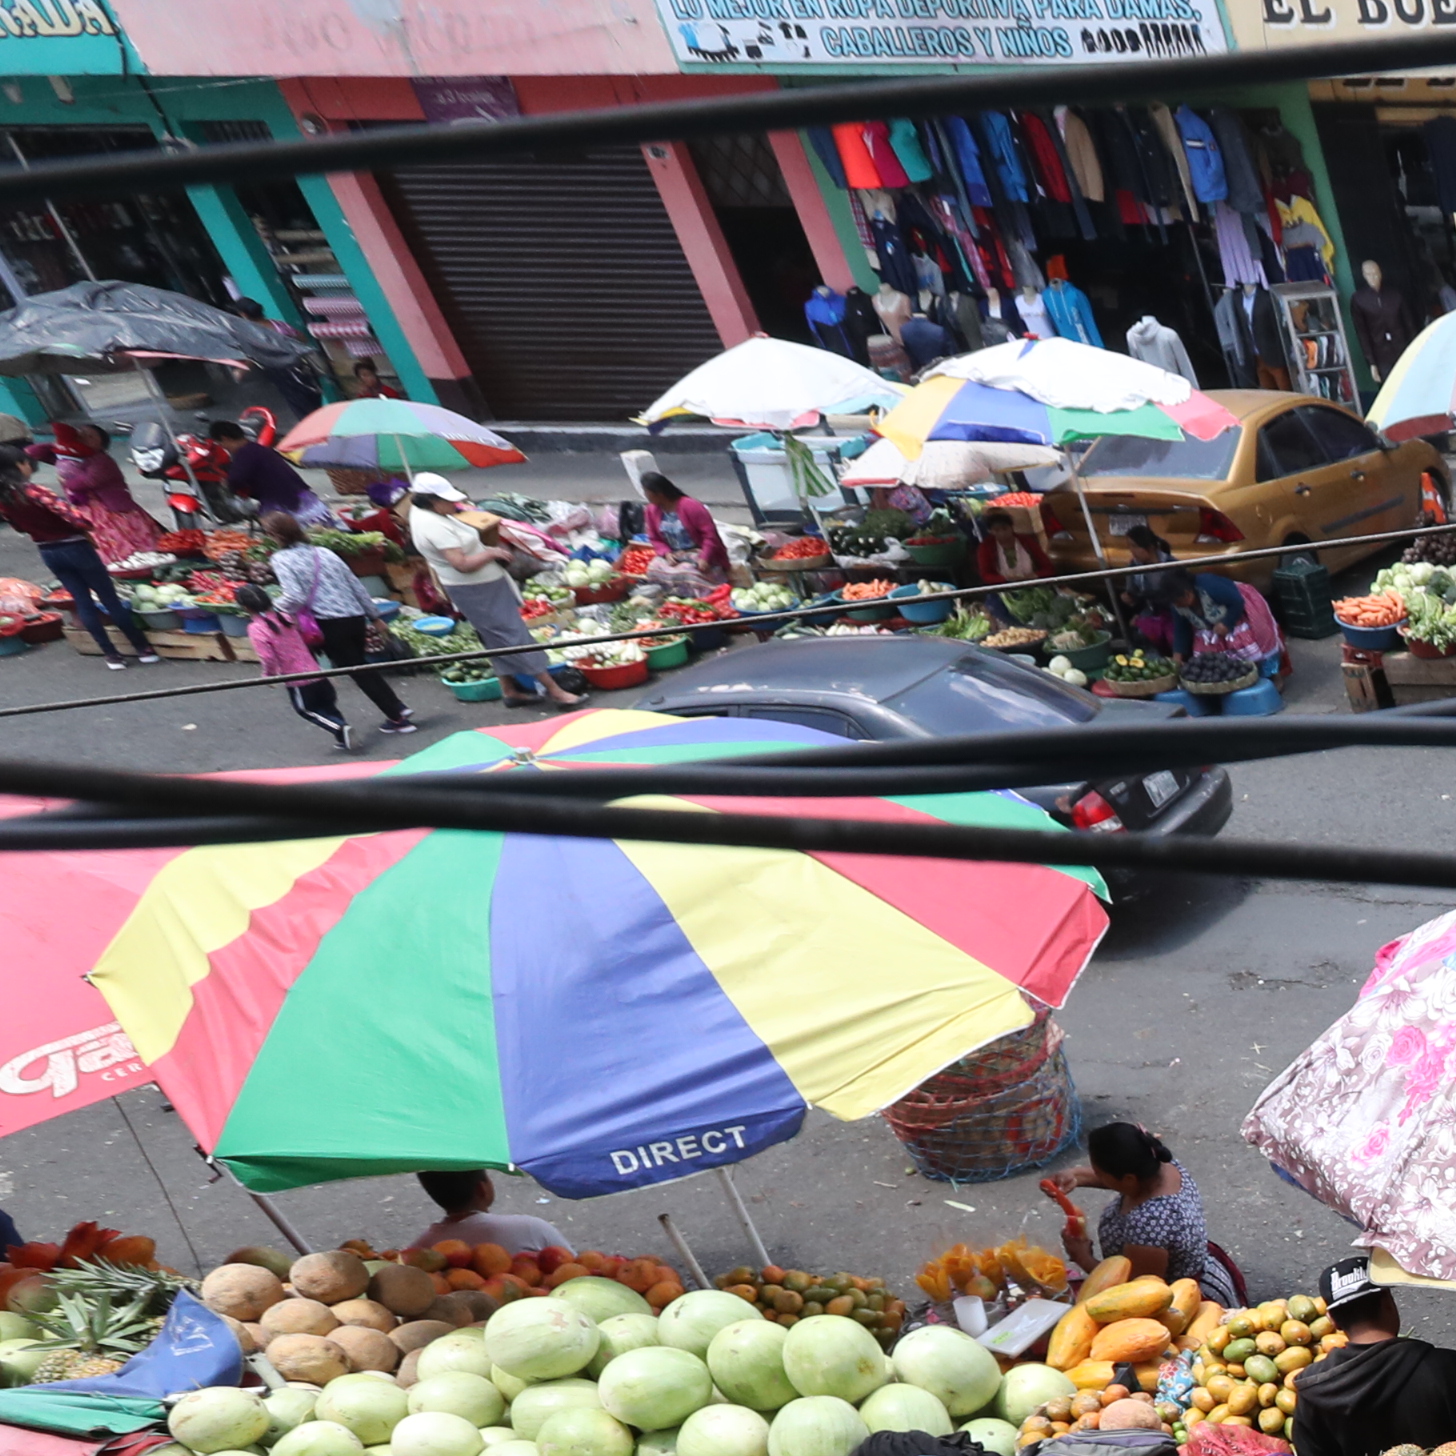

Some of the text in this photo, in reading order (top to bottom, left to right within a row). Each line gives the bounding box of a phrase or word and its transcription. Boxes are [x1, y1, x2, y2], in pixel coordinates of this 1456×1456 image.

[820, 14, 1074, 58] CABALLEROS Y NIÑOS
[609, 1125, 747, 1175] DIRECT
